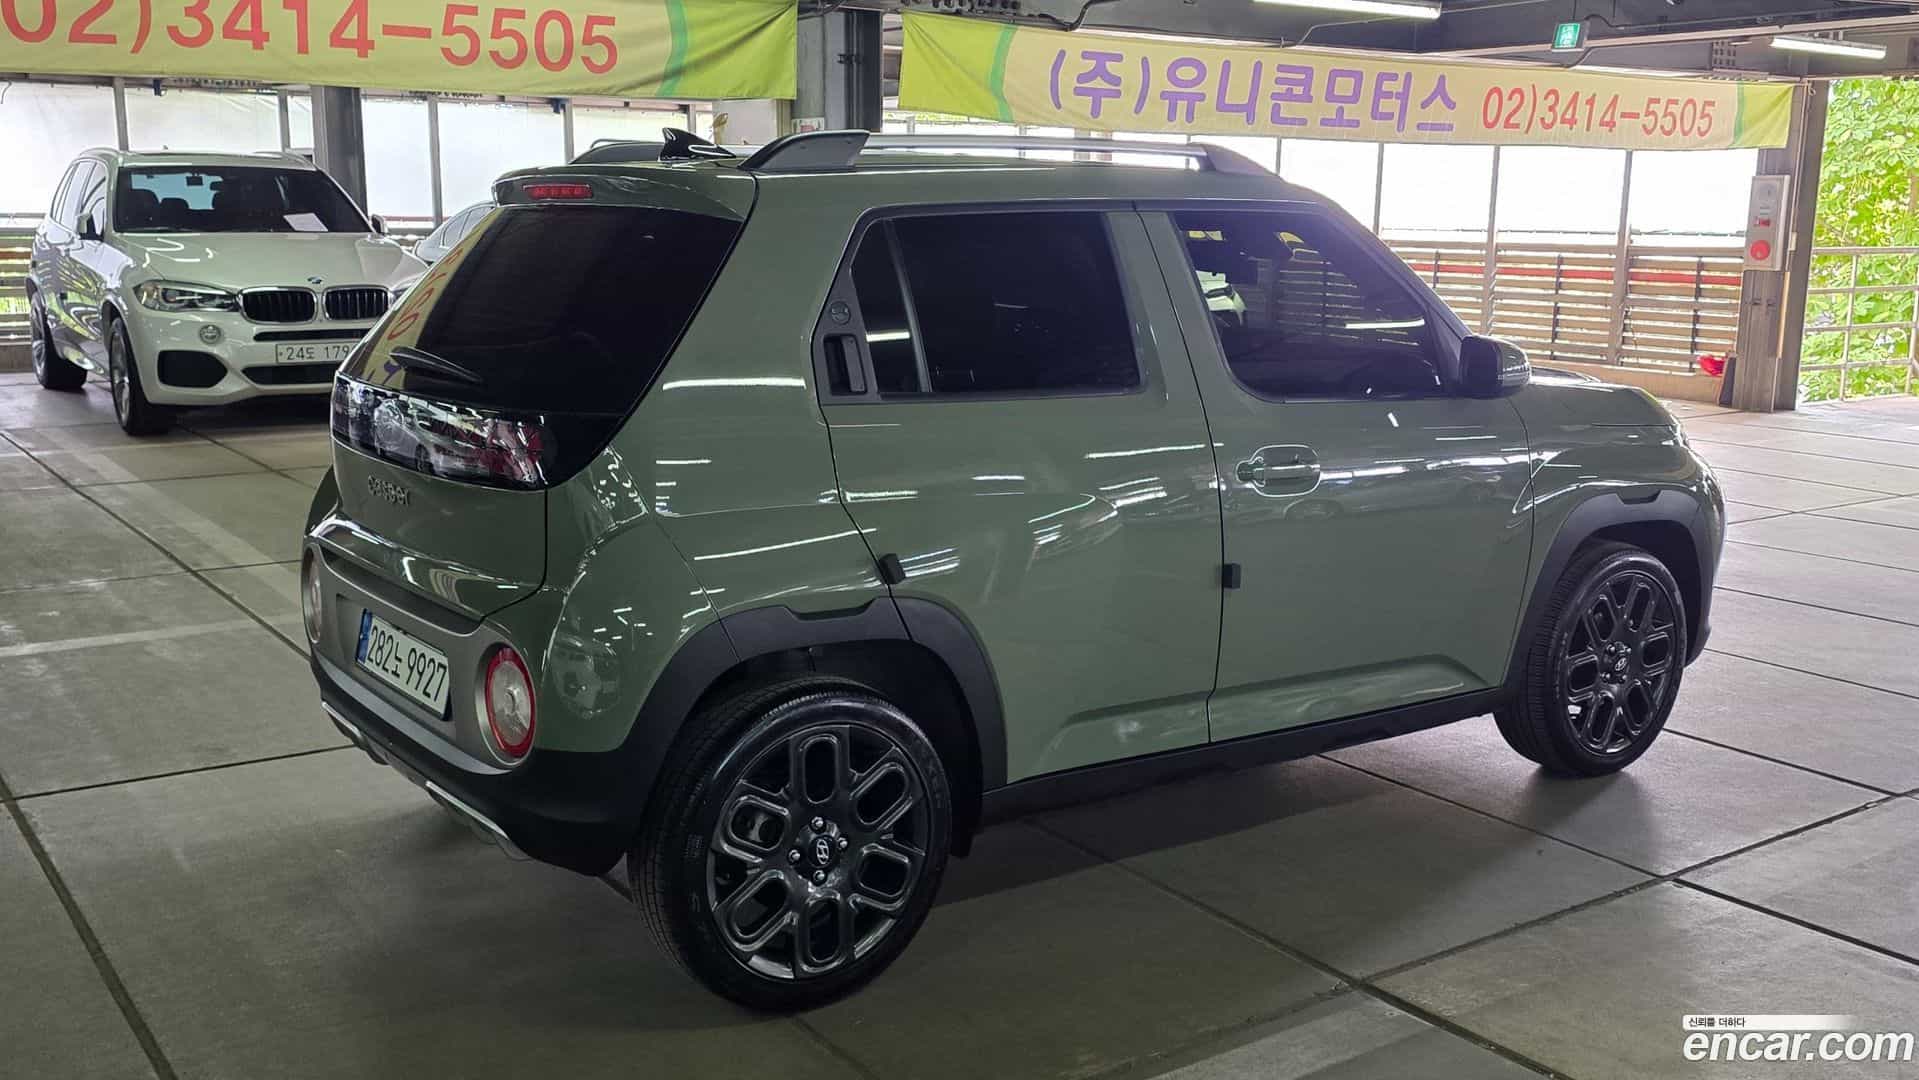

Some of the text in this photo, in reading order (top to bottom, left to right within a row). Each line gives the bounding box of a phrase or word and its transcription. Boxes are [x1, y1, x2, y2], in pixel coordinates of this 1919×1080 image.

[1, 0, 618, 74] 02)3414-5505
[1049, 48, 1716, 137] (주)유니콘모터스 02)3414-5505
[324, 344, 355, 360] 179
[367, 625, 447, 702] 282노 9927
